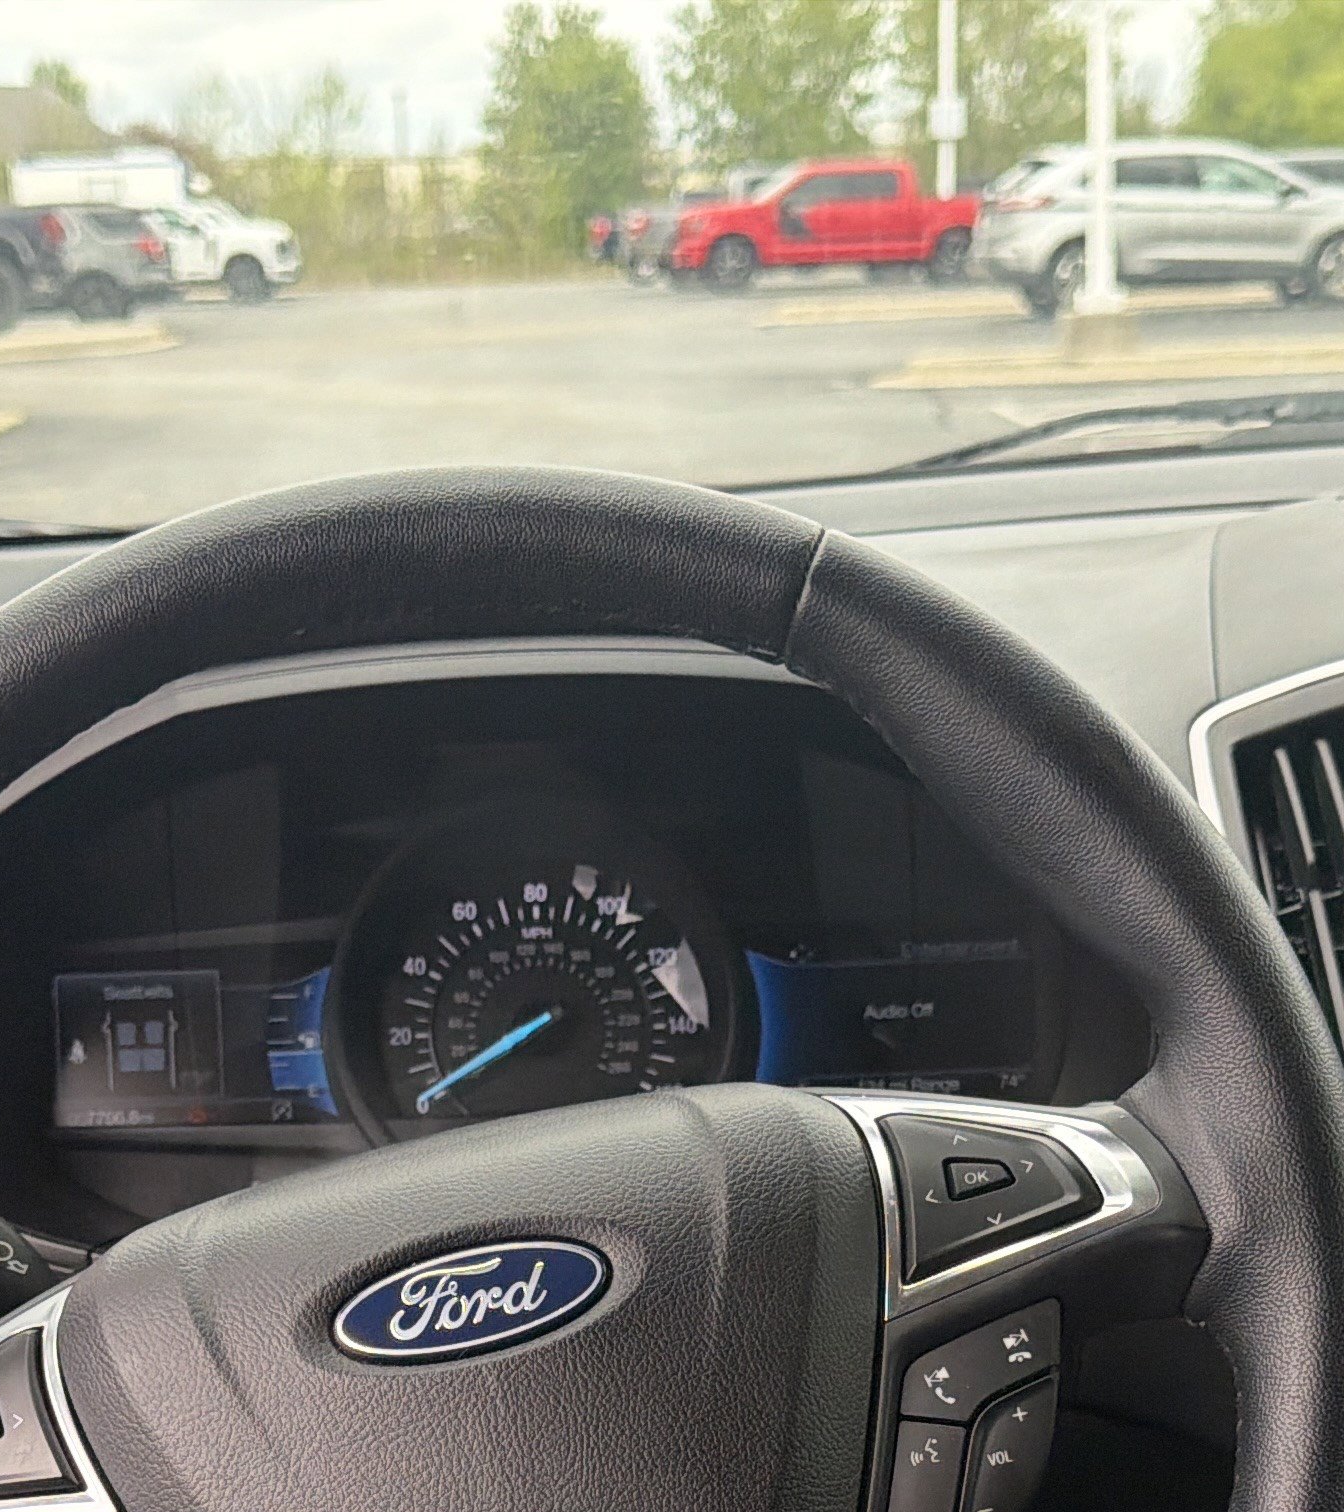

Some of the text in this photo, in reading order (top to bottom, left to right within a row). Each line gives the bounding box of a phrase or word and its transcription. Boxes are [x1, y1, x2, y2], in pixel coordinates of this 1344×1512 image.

[523, 883, 548, 902] 80
[452, 902, 478, 921] 60
[402, 957, 427, 976] 40
[389, 1027, 413, 1046] 20
[964, 1168, 991, 1186] OK
[389, 1256, 548, 1342] Ford
[986, 1450, 1014, 1467] VOL
